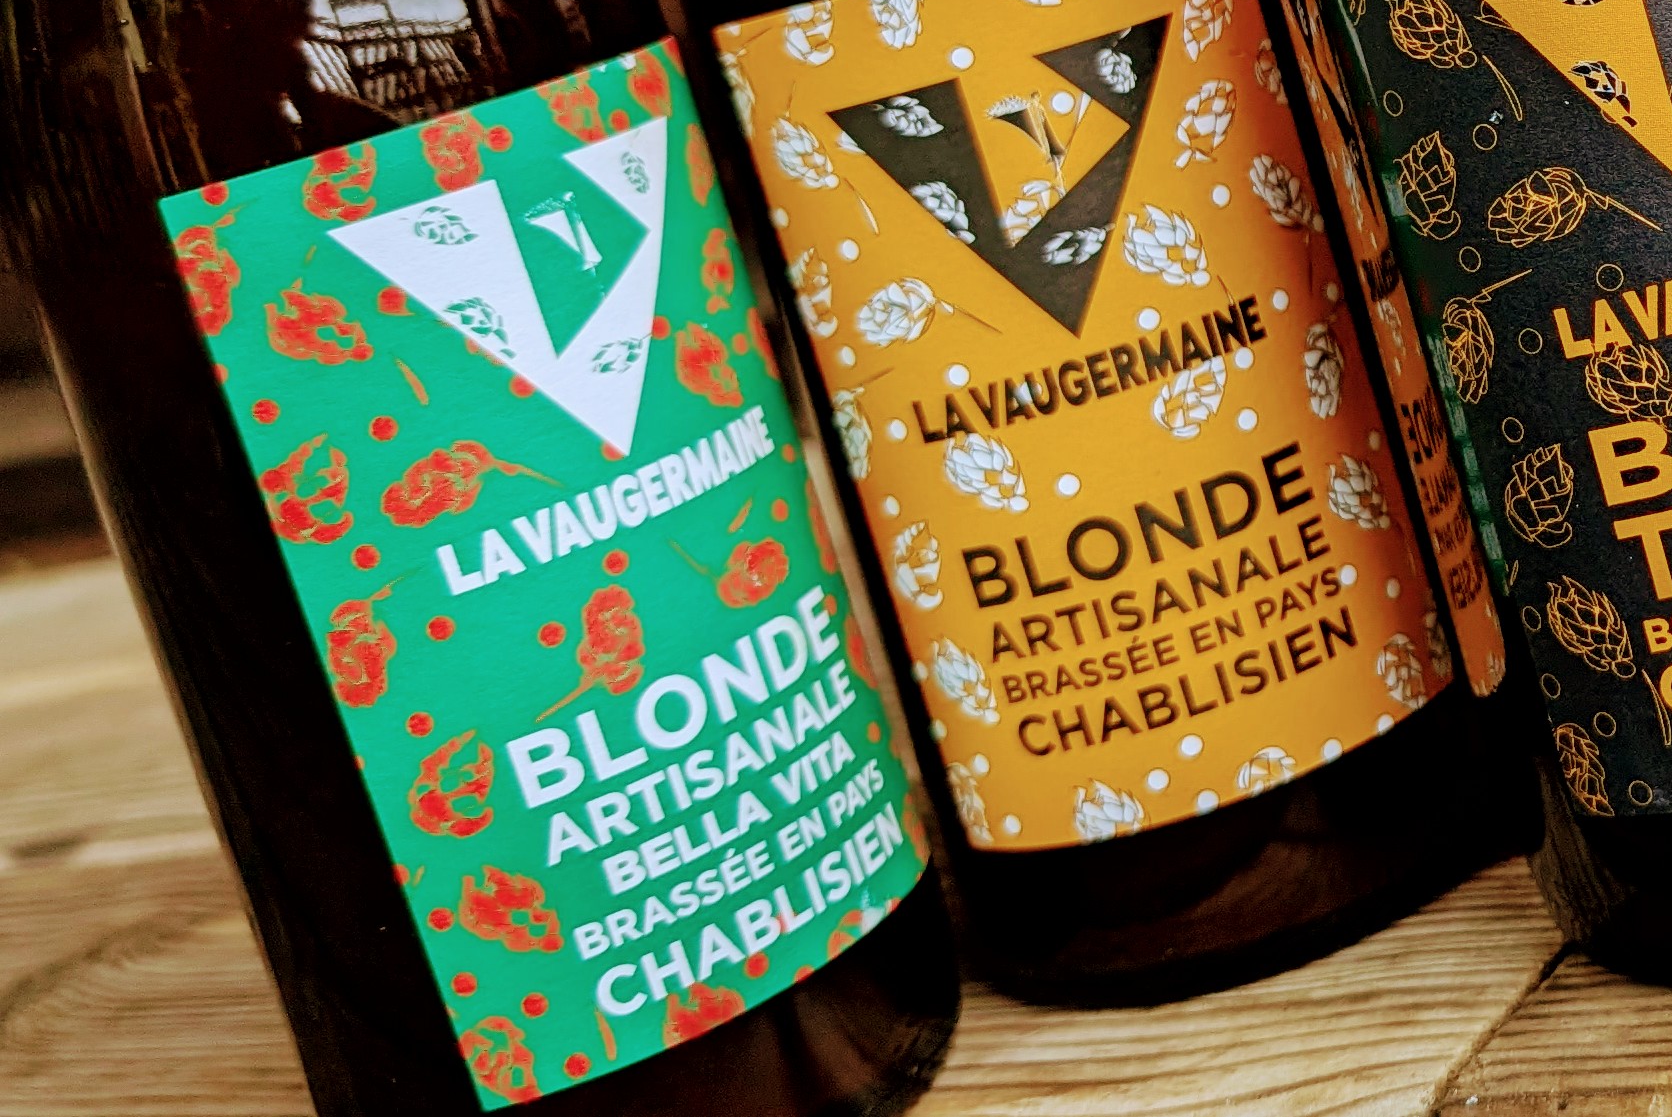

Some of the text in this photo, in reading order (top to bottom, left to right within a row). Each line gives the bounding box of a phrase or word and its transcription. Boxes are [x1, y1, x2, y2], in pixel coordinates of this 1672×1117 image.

[912, 294, 1266, 444] LA VAUGERMAINE
[1553, 301, 1631, 360] LA
[436, 405, 775, 596] LA VAUGERMAINE
[961, 441, 1315, 609] BLONDE
[991, 514, 1332, 664] ARTISANALE
[1002, 566, 1342, 704] BRASSÉE EN PAYS
[506, 585, 840, 809] BLONDE
[547, 659, 857, 867] ARTISANALE
[1017, 606, 1359, 757] CHABLISIEN
[573, 758, 886, 961] BRASSÉE EN PAYS
[602, 731, 857, 896] BELLA VITA
[596, 801, 904, 1007] CHABLISIEN
